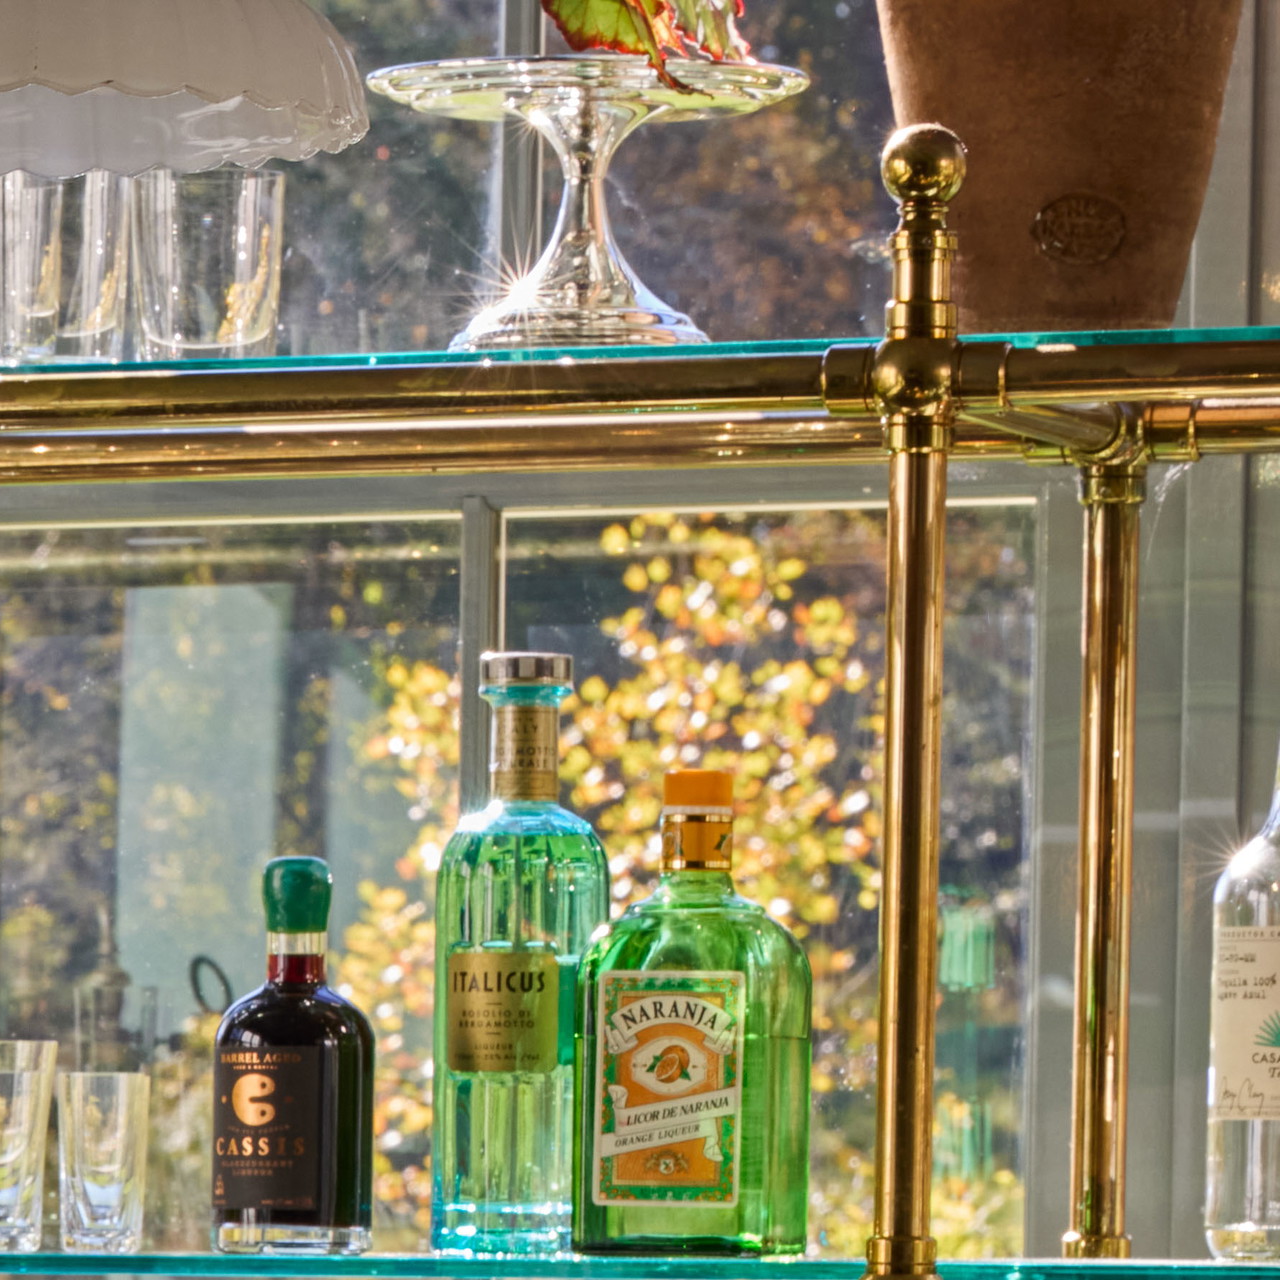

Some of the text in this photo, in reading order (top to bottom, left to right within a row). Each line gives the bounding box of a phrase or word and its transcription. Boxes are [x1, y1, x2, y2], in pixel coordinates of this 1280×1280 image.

[453, 971, 545, 993] ITALICUS
[458, 1020, 535, 1029] BERGAMOTTO
[620, 1000, 718, 1031] NARANJA
[221, 1051, 302, 1064] BARREL AGED
[626, 1096, 730, 1127] LICOR DE NARANJA
[216, 1136, 304, 1156] CASSIS
[614, 1123, 701, 1148] ORANGE LIQUEUR
